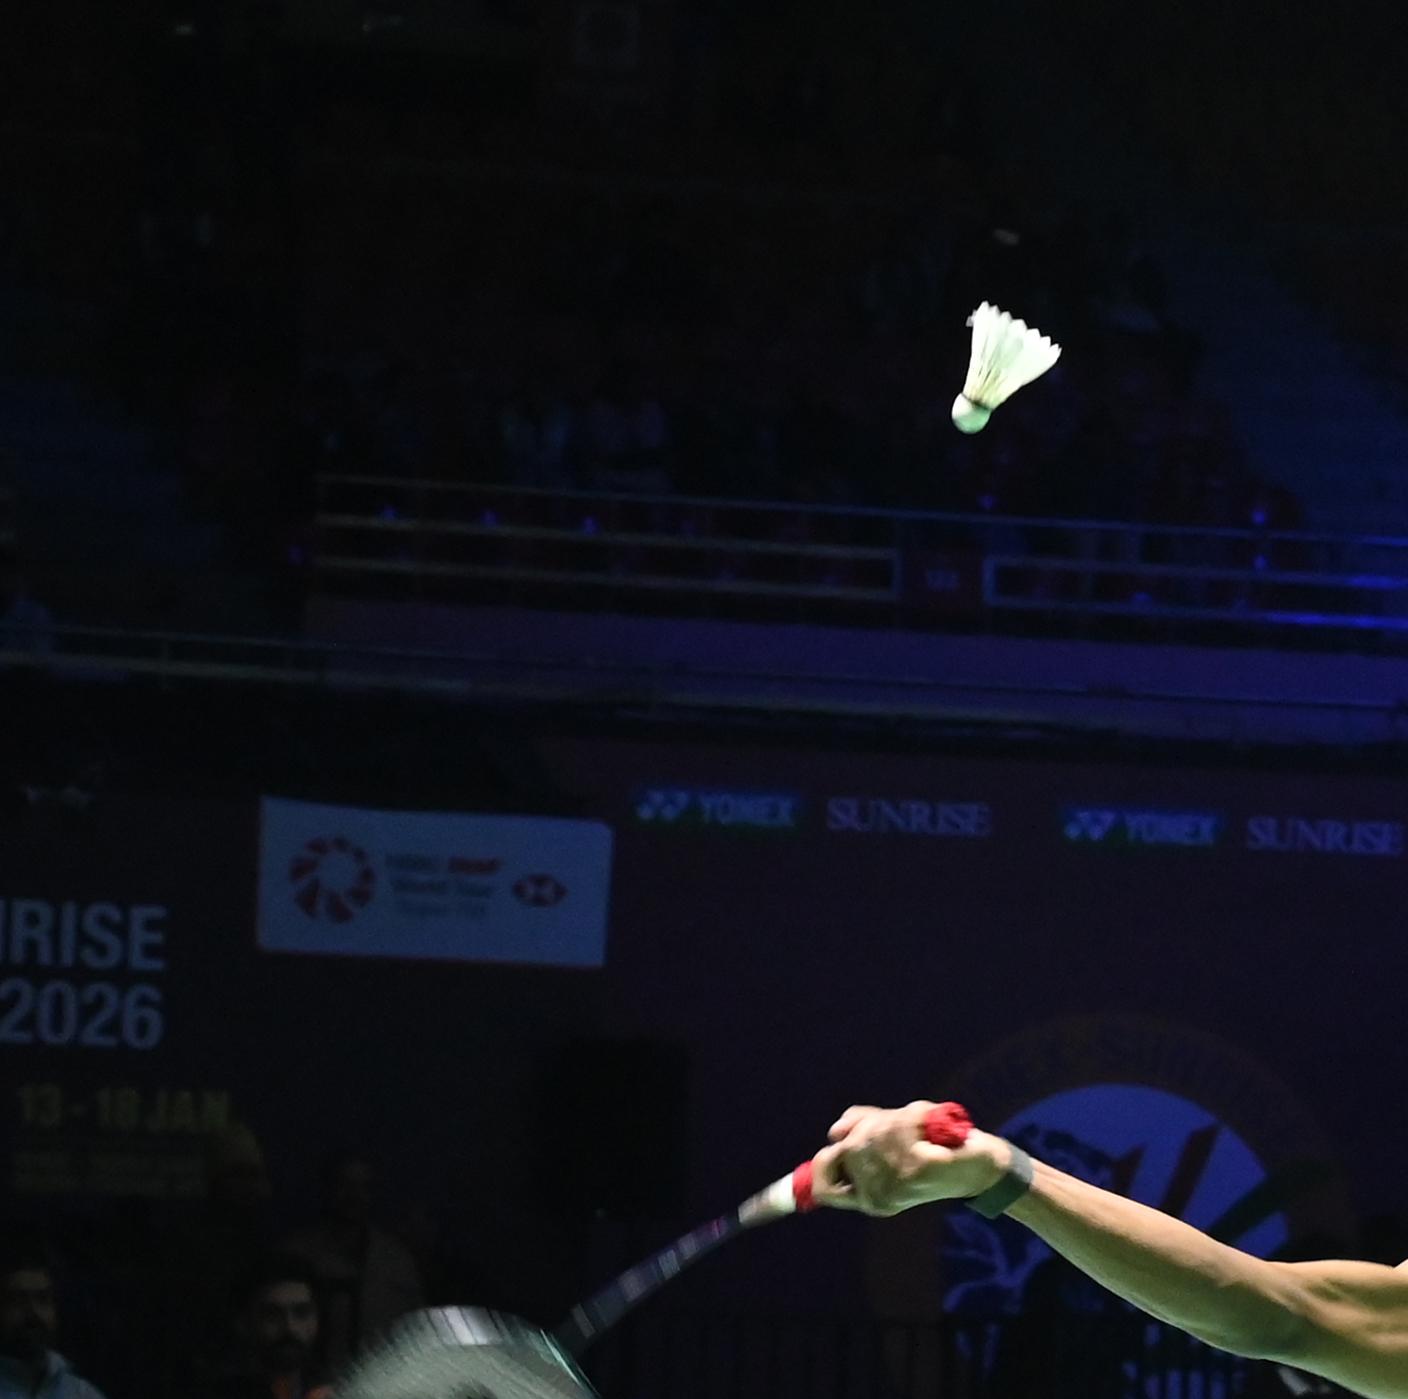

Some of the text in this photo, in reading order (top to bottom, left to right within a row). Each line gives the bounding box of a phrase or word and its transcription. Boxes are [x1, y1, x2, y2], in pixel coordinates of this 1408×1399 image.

[826, 797, 992, 837] SUNRISE
[1247, 816, 1405, 856] SUNRISE
[0, 898, 168, 971] RISE
[0, 977, 164, 1050] 2026
